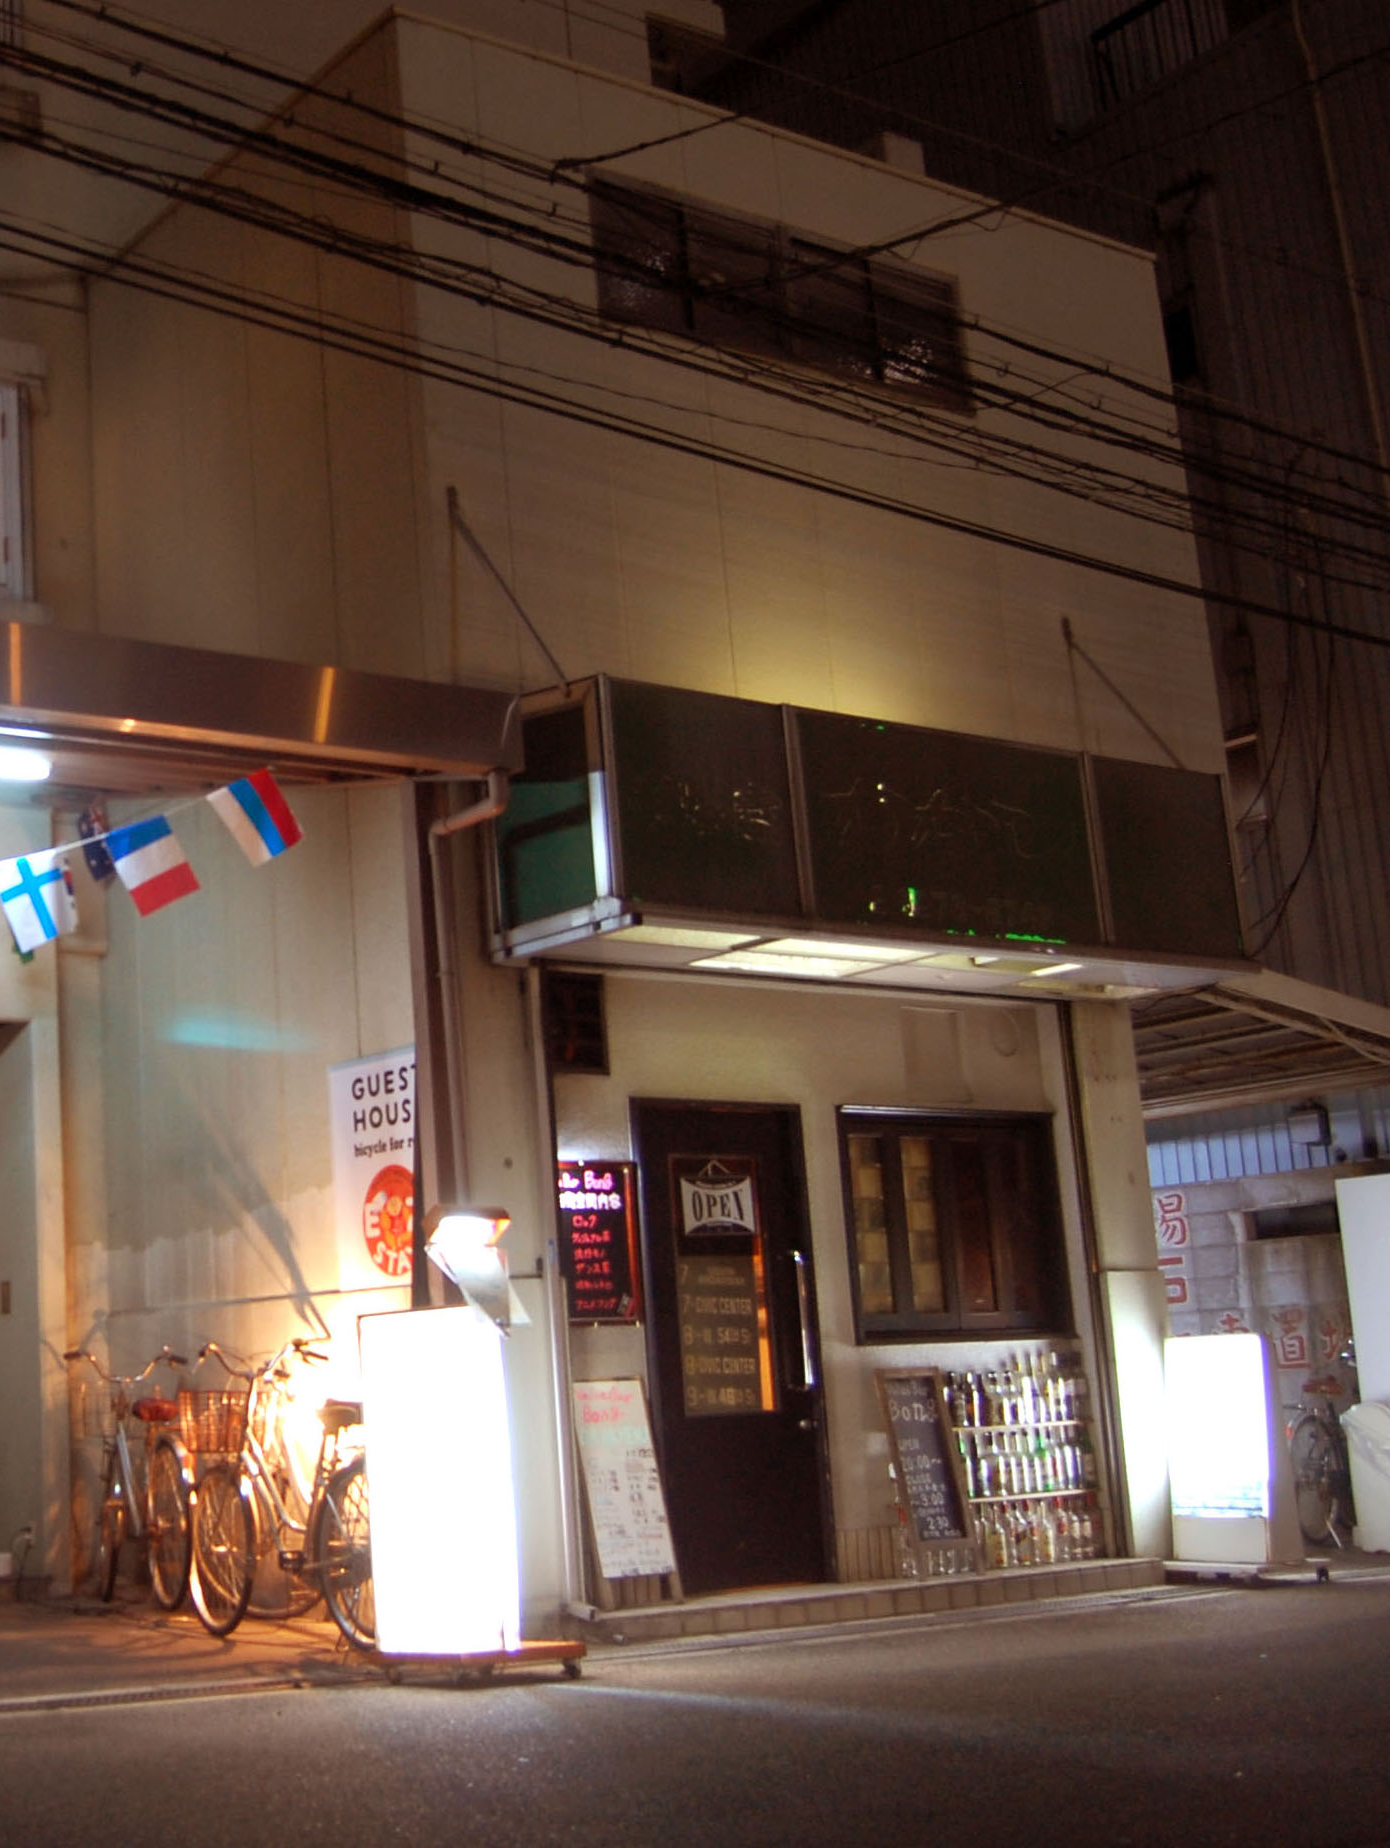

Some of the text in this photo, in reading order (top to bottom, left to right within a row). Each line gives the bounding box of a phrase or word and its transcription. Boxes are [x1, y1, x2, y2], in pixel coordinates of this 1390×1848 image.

[351, 1065, 416, 1101] GUES
[353, 1099, 412, 1133] HOUS
[353, 1138, 387, 1160] bicycle
[389, 1136, 405, 1151] for
[691, 1188, 745, 1223] OPEN
